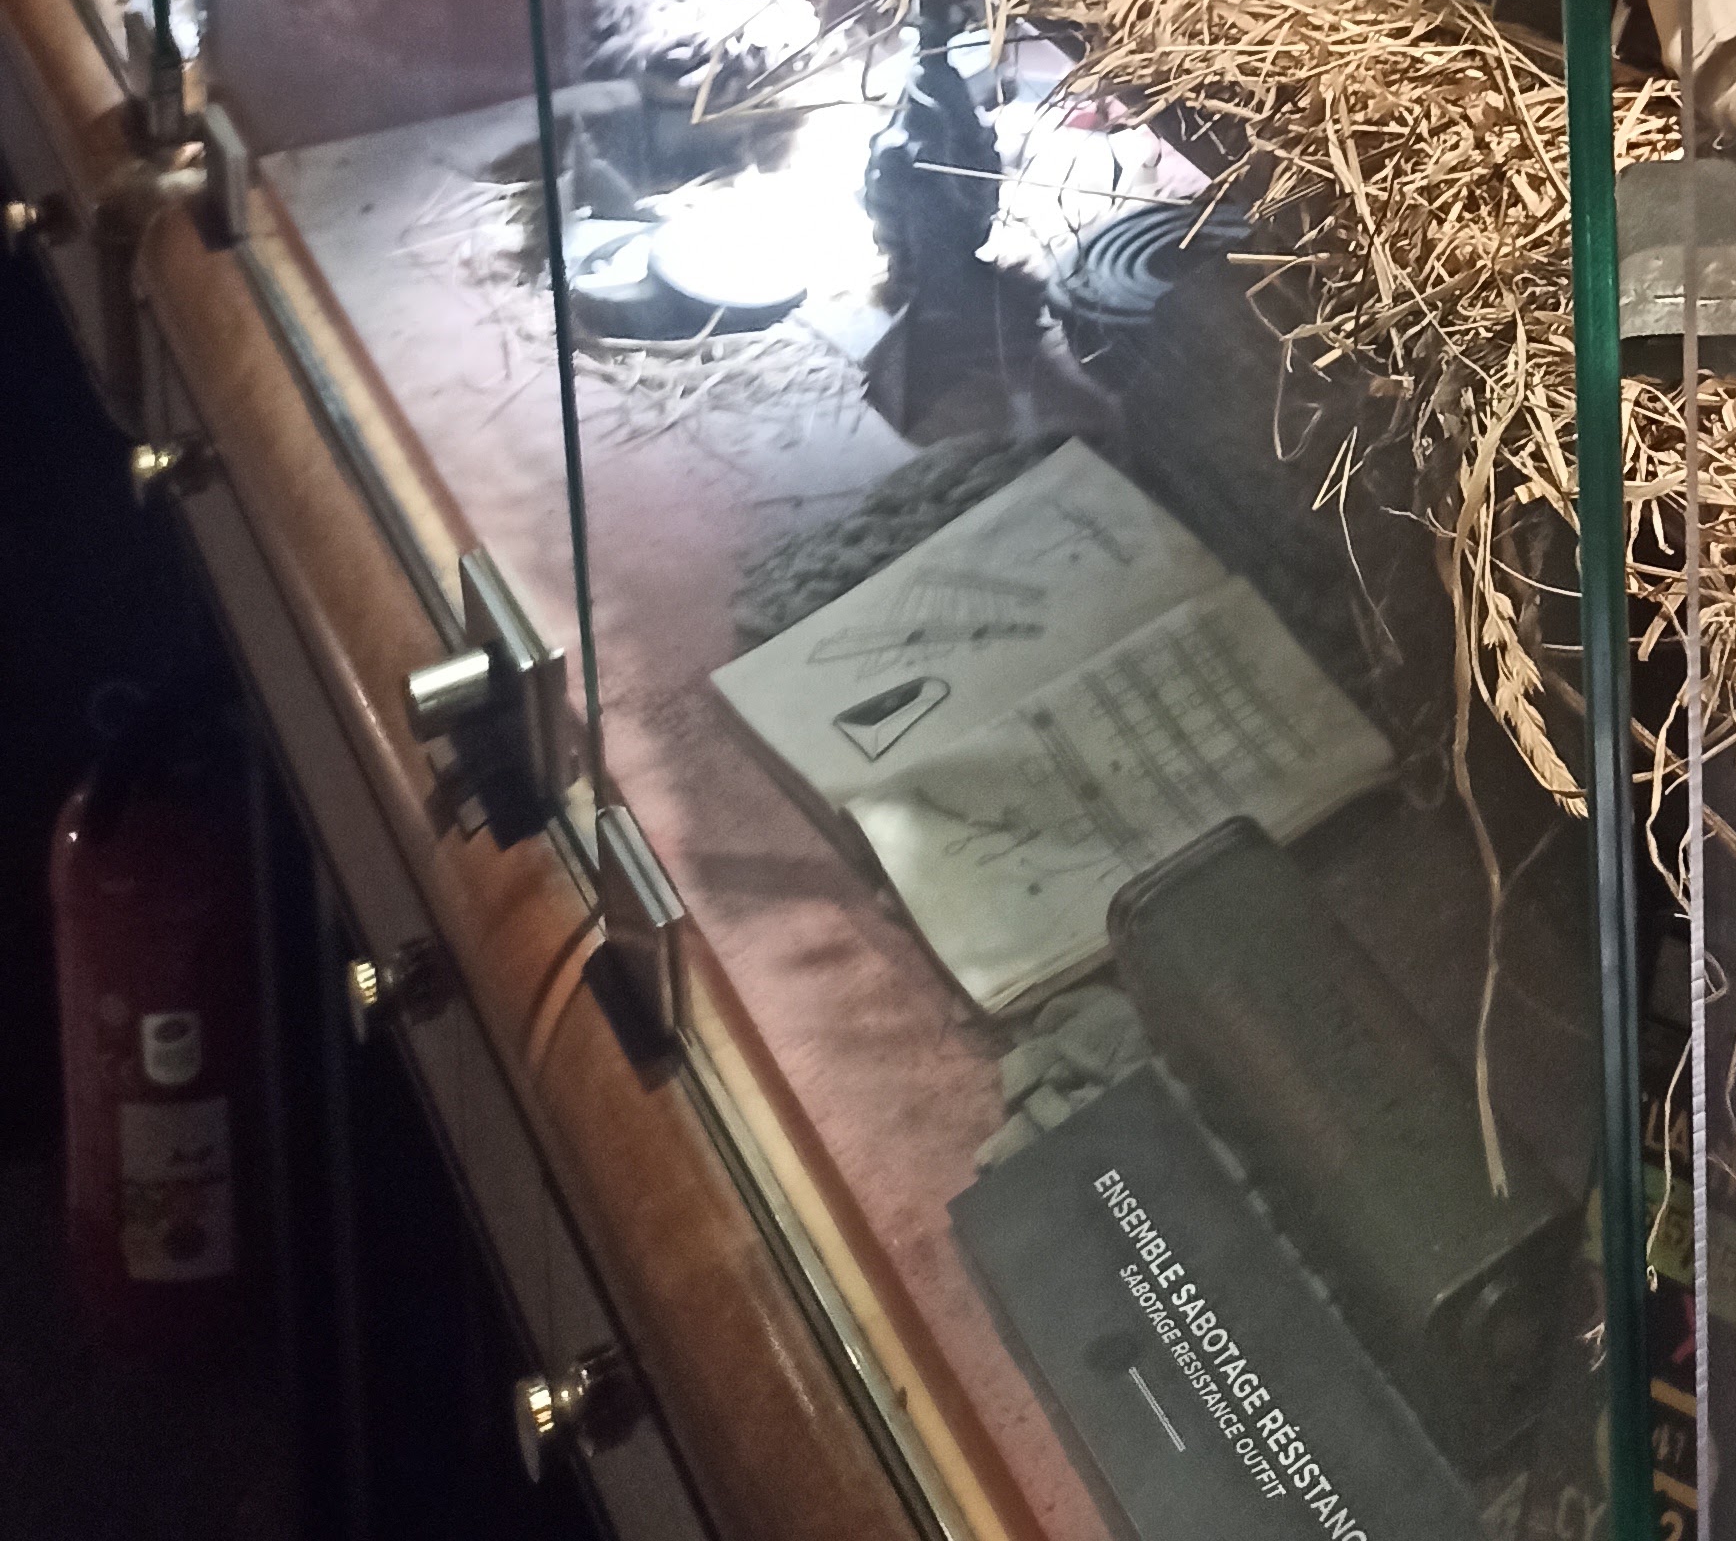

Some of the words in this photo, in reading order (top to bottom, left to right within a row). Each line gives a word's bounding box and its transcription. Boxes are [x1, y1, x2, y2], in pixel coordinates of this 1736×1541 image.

[1093, 1168, 1185, 1289] ENSEMBLE
[1171, 1283, 1271, 1415] SABOTAGE
[1119, 1264, 1181, 1345] SABOTAGE
[1170, 1340, 1246, 1440] RESISTANCE
[1236, 1436, 1288, 1500] OUTFIT
